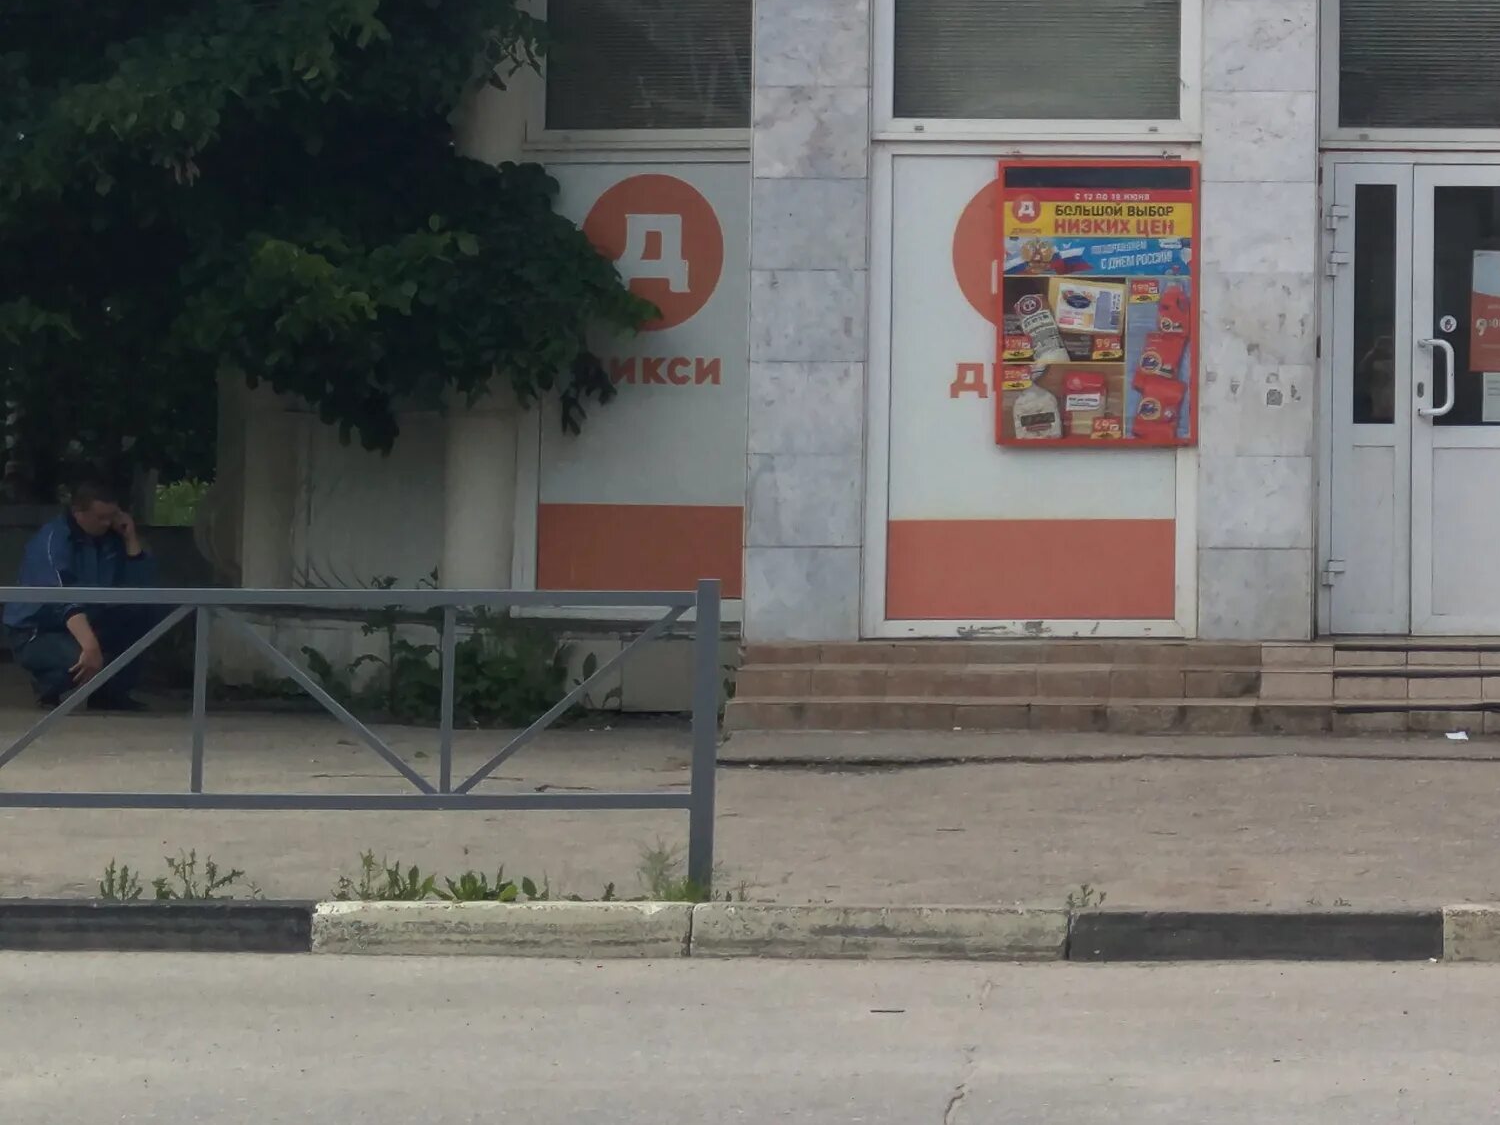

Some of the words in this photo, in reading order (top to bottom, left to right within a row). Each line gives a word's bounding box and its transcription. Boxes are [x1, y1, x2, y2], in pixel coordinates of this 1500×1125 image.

[1055, 203, 1123, 216] БОЛЬШОЙ
[1128, 205, 1175, 216] ВЫБОР
[1055, 219, 1131, 234] НИЗКИХ
[1136, 219, 1175, 236] ЦЕН
[608, 356, 722, 386] ИКСИ
